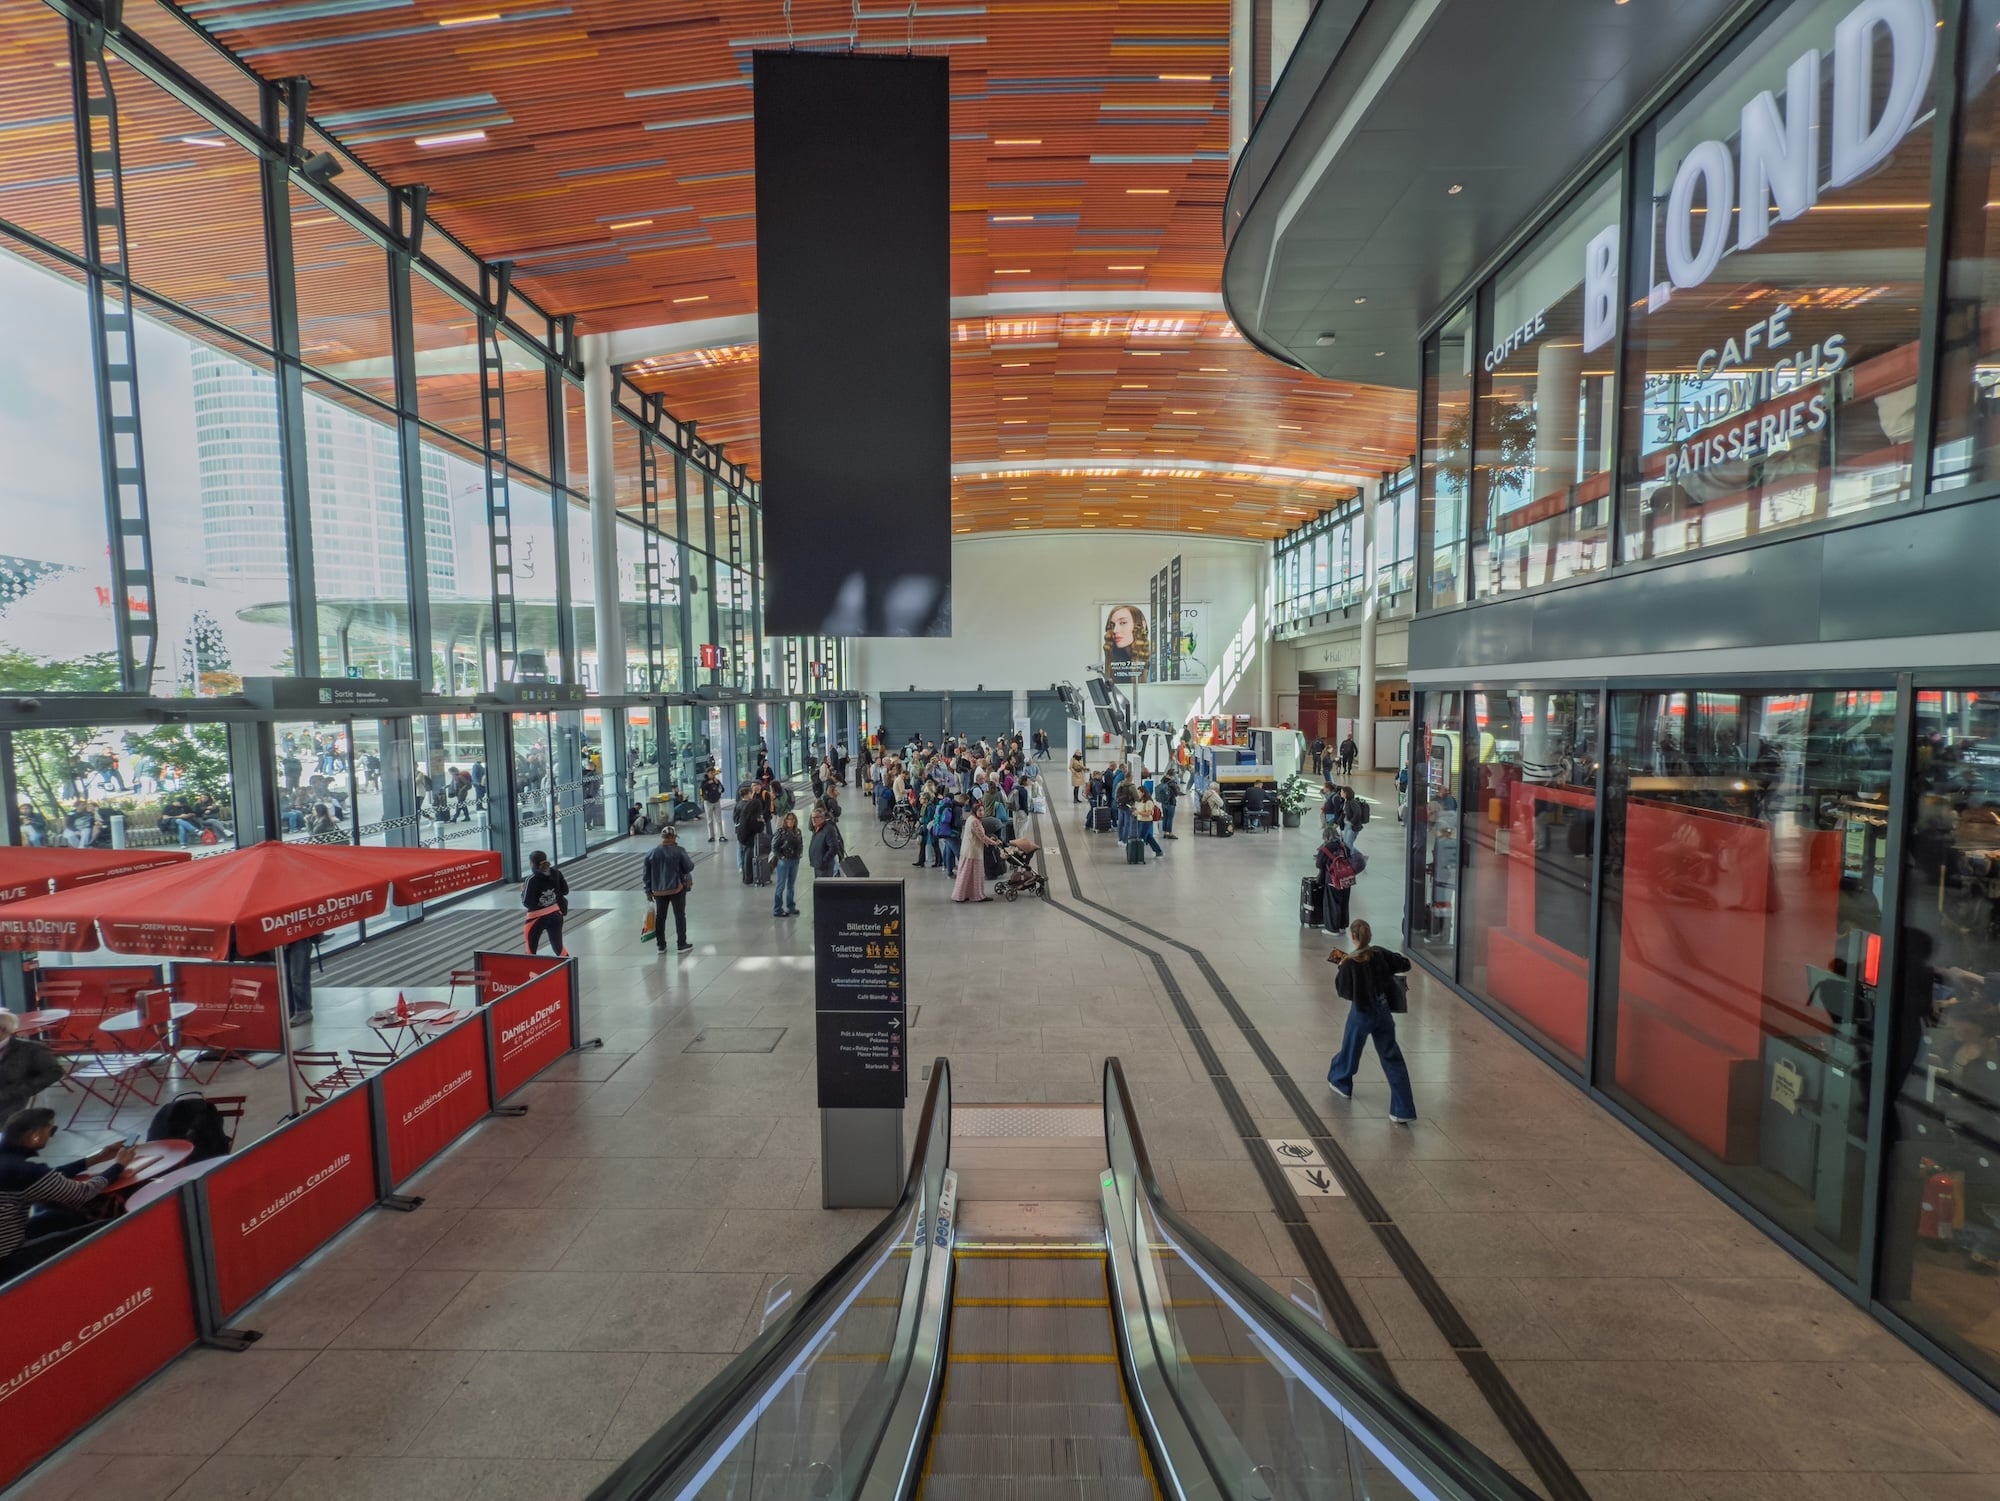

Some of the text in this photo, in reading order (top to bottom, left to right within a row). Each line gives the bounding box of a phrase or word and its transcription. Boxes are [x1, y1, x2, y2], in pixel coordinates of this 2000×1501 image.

[1484, 308, 1546, 372] COFFEE
[1696, 303, 1793, 381] CAFÉ
[1656, 334, 1848, 443] SANDWICHS
[1665, 395, 1827, 483] PÂTISSERIES
[334, 690, 354, 698] Sortie
[434, 863, 472, 878] JOSEPH VIOLA
[140, 923, 188, 933] JOSEPH VIOLA
[286, 908, 355, 936] EN VOYAGE
[846, 923, 881, 931] Billetterie
[831, 944, 863, 953] Toilettes
[525, 1017, 551, 1038] VOYAGE
[402, 1069, 473, 1122] La cuisine Canaille
[241, 1153, 351, 1232] La cuisine Canaille
[0, 1286, 152, 1396] cuisine Canaille
